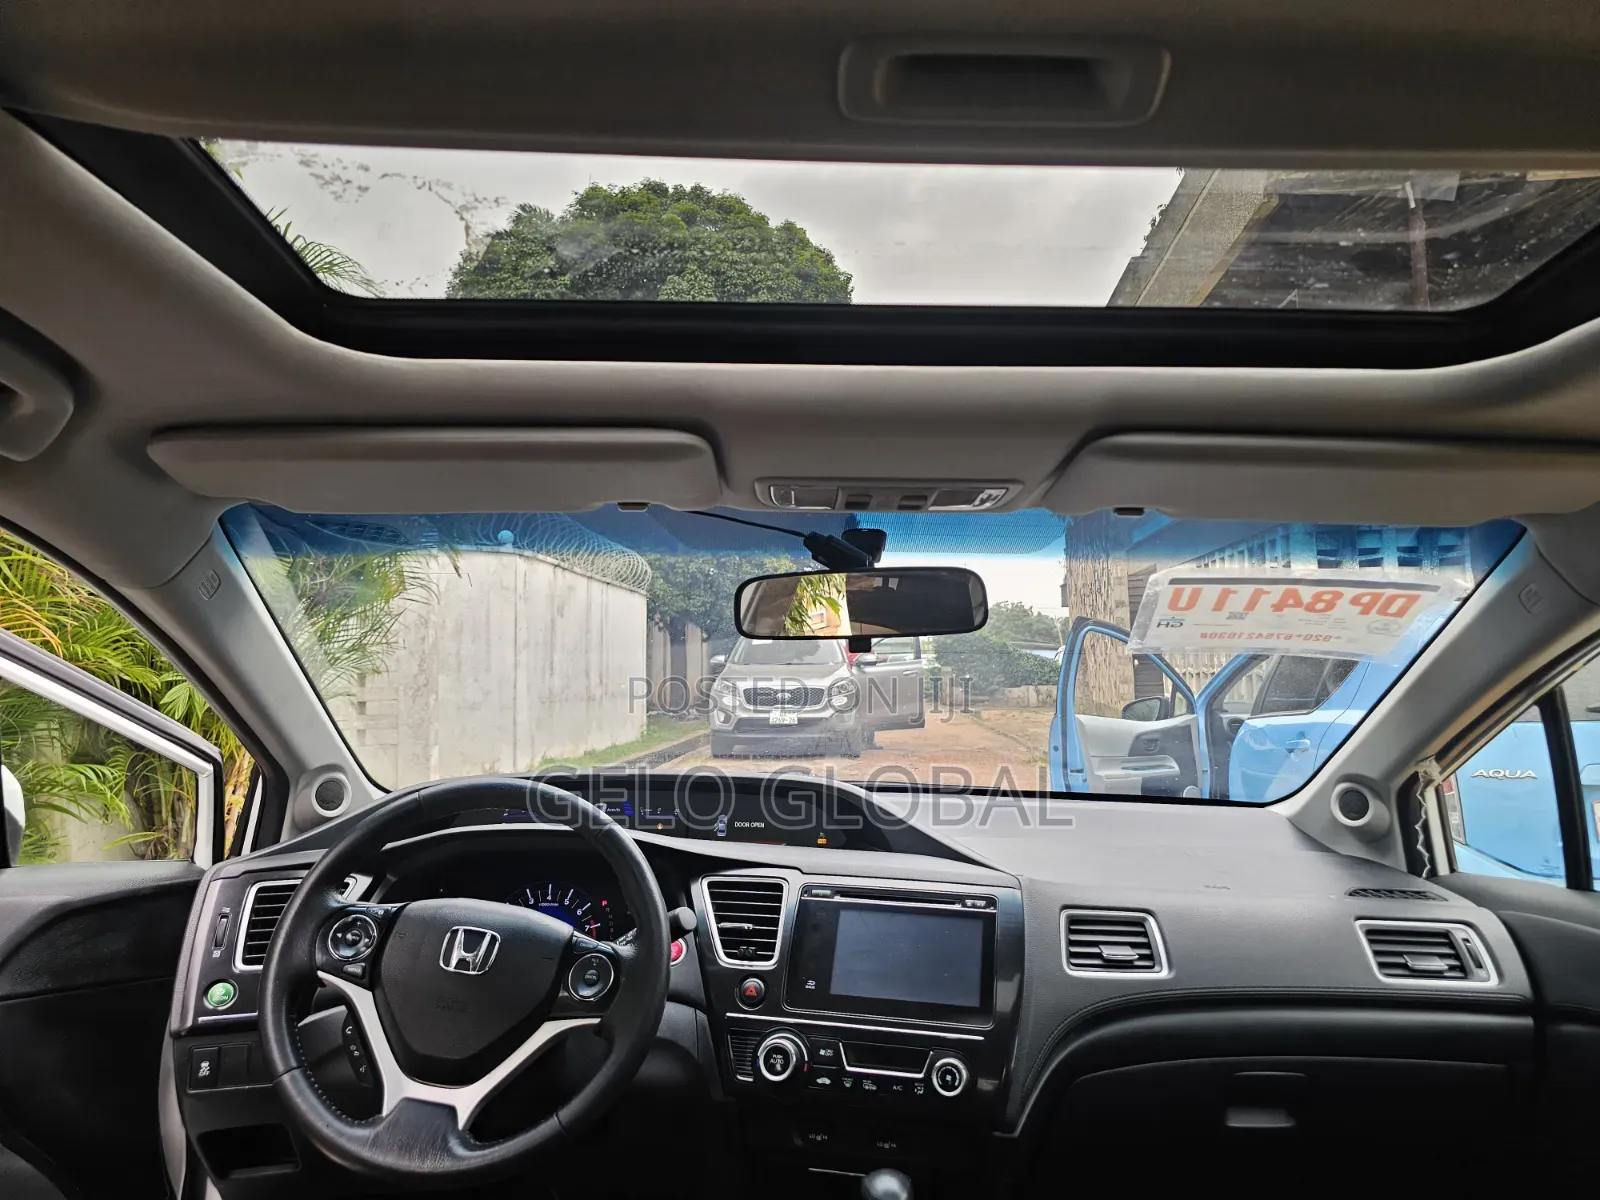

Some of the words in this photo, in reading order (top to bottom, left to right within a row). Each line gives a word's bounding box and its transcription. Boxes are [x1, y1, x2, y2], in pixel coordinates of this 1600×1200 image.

[1471, 768, 1537, 780] AQUA
[576, 908, 583, 916] 6
[584, 924, 590, 932] 7
